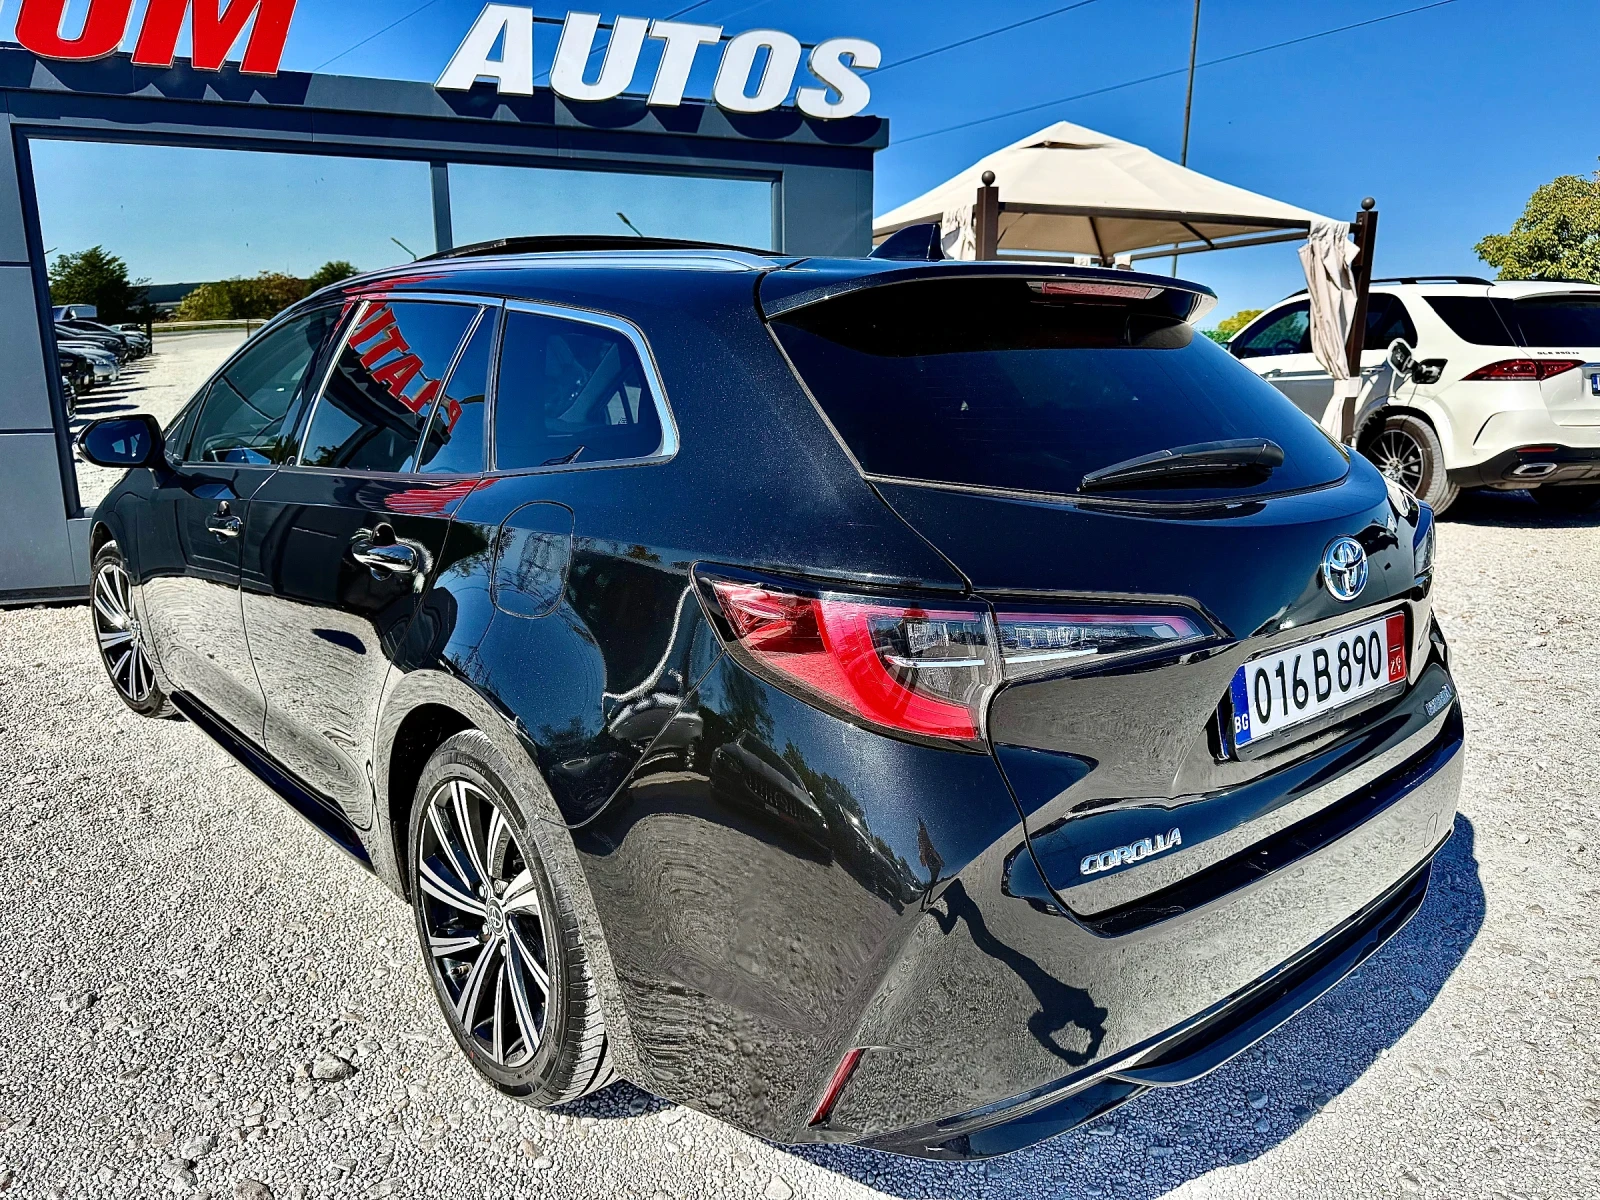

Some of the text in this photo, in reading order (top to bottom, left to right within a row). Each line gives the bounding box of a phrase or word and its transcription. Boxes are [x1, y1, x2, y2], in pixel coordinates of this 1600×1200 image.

[434, 2, 882, 119] AUTOS
[1254, 630, 1382, 724] 016B890
[1234, 713, 1249, 734] BG
[1080, 827, 1183, 876] COROLLA
